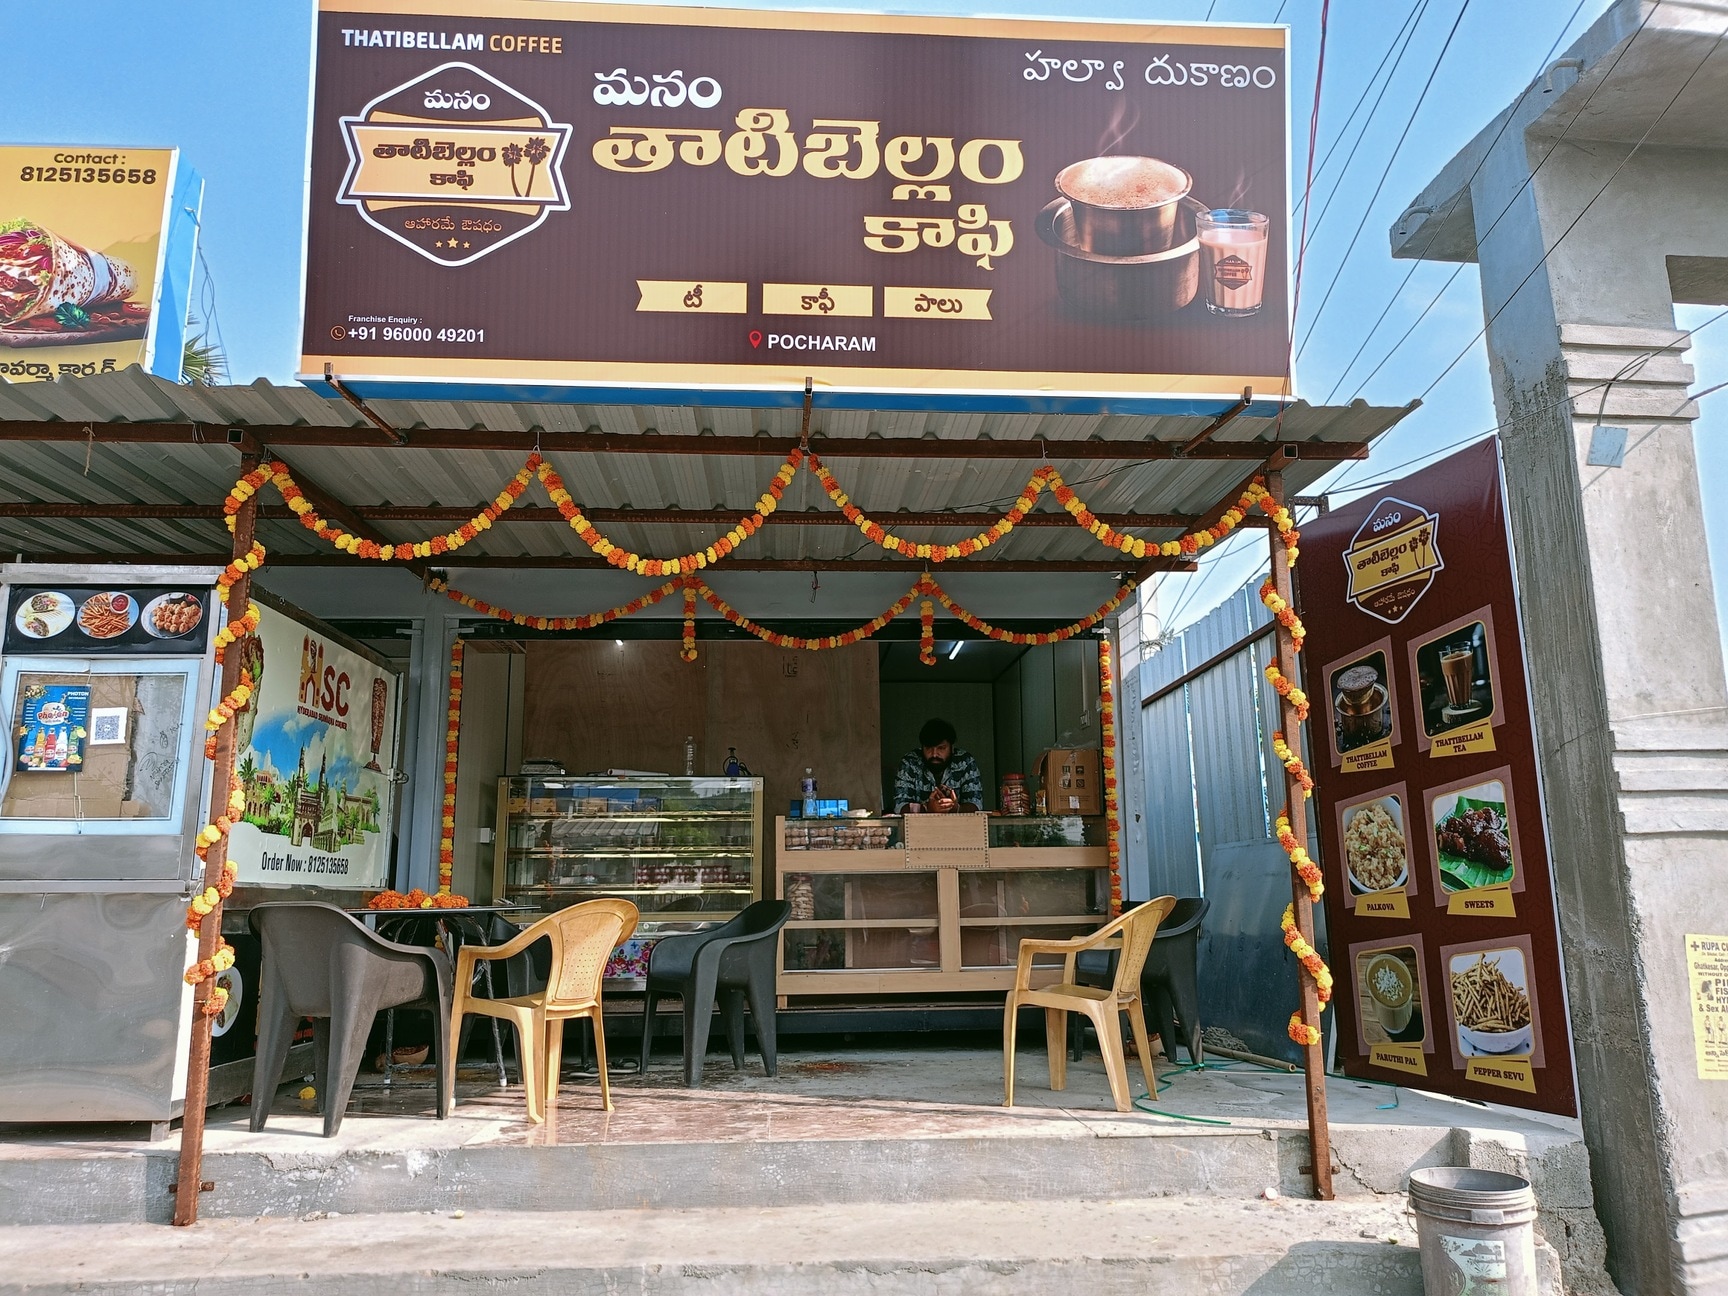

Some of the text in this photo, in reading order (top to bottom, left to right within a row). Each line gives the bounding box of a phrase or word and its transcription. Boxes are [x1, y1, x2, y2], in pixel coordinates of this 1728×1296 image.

[341, 29, 563, 54] THATIBELLAM COFFEE
[1023, 49, 1276, 91] హల్వా దుకాణం
[592, 67, 722, 109] మనం
[423, 89, 491, 110] మనం
[54, 153, 118, 165] Contact
[592, 107, 1025, 202] తాటిబెల్లం
[20, 166, 157, 185] 8125135658
[429, 169, 475, 191] కాఫి
[404, 216, 503, 233] ఆహారమే ఔషధం
[863, 203, 1015, 271] కాఫి
[683, 284, 703, 308] టీ
[800, 287, 835, 314] కాఫీ
[914, 294, 963, 313] పాలు
[348, 315, 387, 323] Franchise
[388, 315, 418, 325] Enquiry
[348, 326, 485, 343] +91 96000 49201
[767, 333, 876, 351] POCHARAM
[1372, 511, 1401, 532] మనం
[1435, 732, 1484, 748] THATTIBELLAM
[1346, 750, 1387, 764] THATTIBELLAM
[1453, 745, 1467, 753] TEA
[1356, 760, 1378, 770] COFFEE
[261, 851, 284, 871] Order
[285, 854, 303, 872] Now
[307, 855, 349, 875] 8125135658
[1366, 903, 1395, 911] PALKOVA
[1464, 900, 1494, 909] SWEETS
[1701, 941, 1720, 951] RUPA
[1706, 1004, 1719, 1013] Sex
[1375, 1052, 1418, 1066] PARUTHI PAL
[1473, 1066, 1525, 1081] PEPPER SEVU
